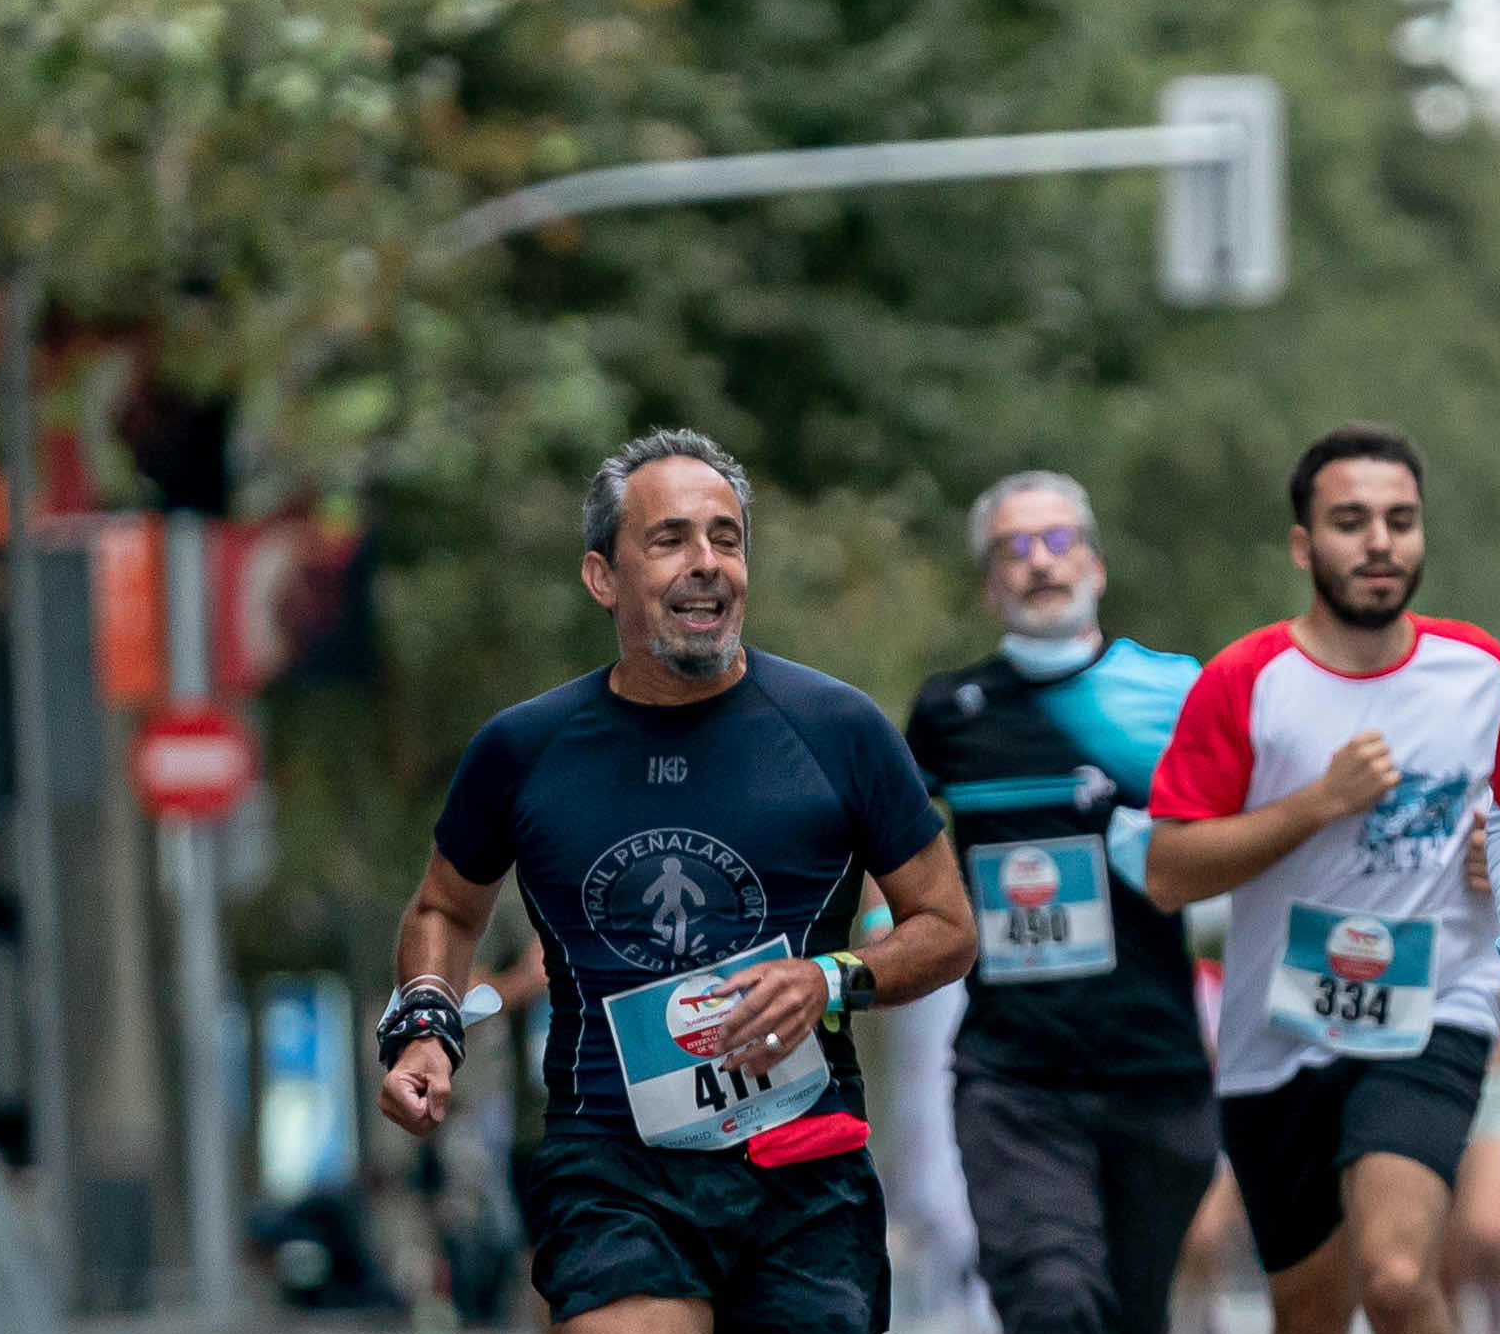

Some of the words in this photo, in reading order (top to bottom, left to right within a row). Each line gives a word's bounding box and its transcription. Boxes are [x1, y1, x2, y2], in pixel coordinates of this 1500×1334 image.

[587, 870, 617, 921] TRAIL
[614, 830, 746, 883] PEÑALARA
[1316, 974, 1389, 1025] 334
